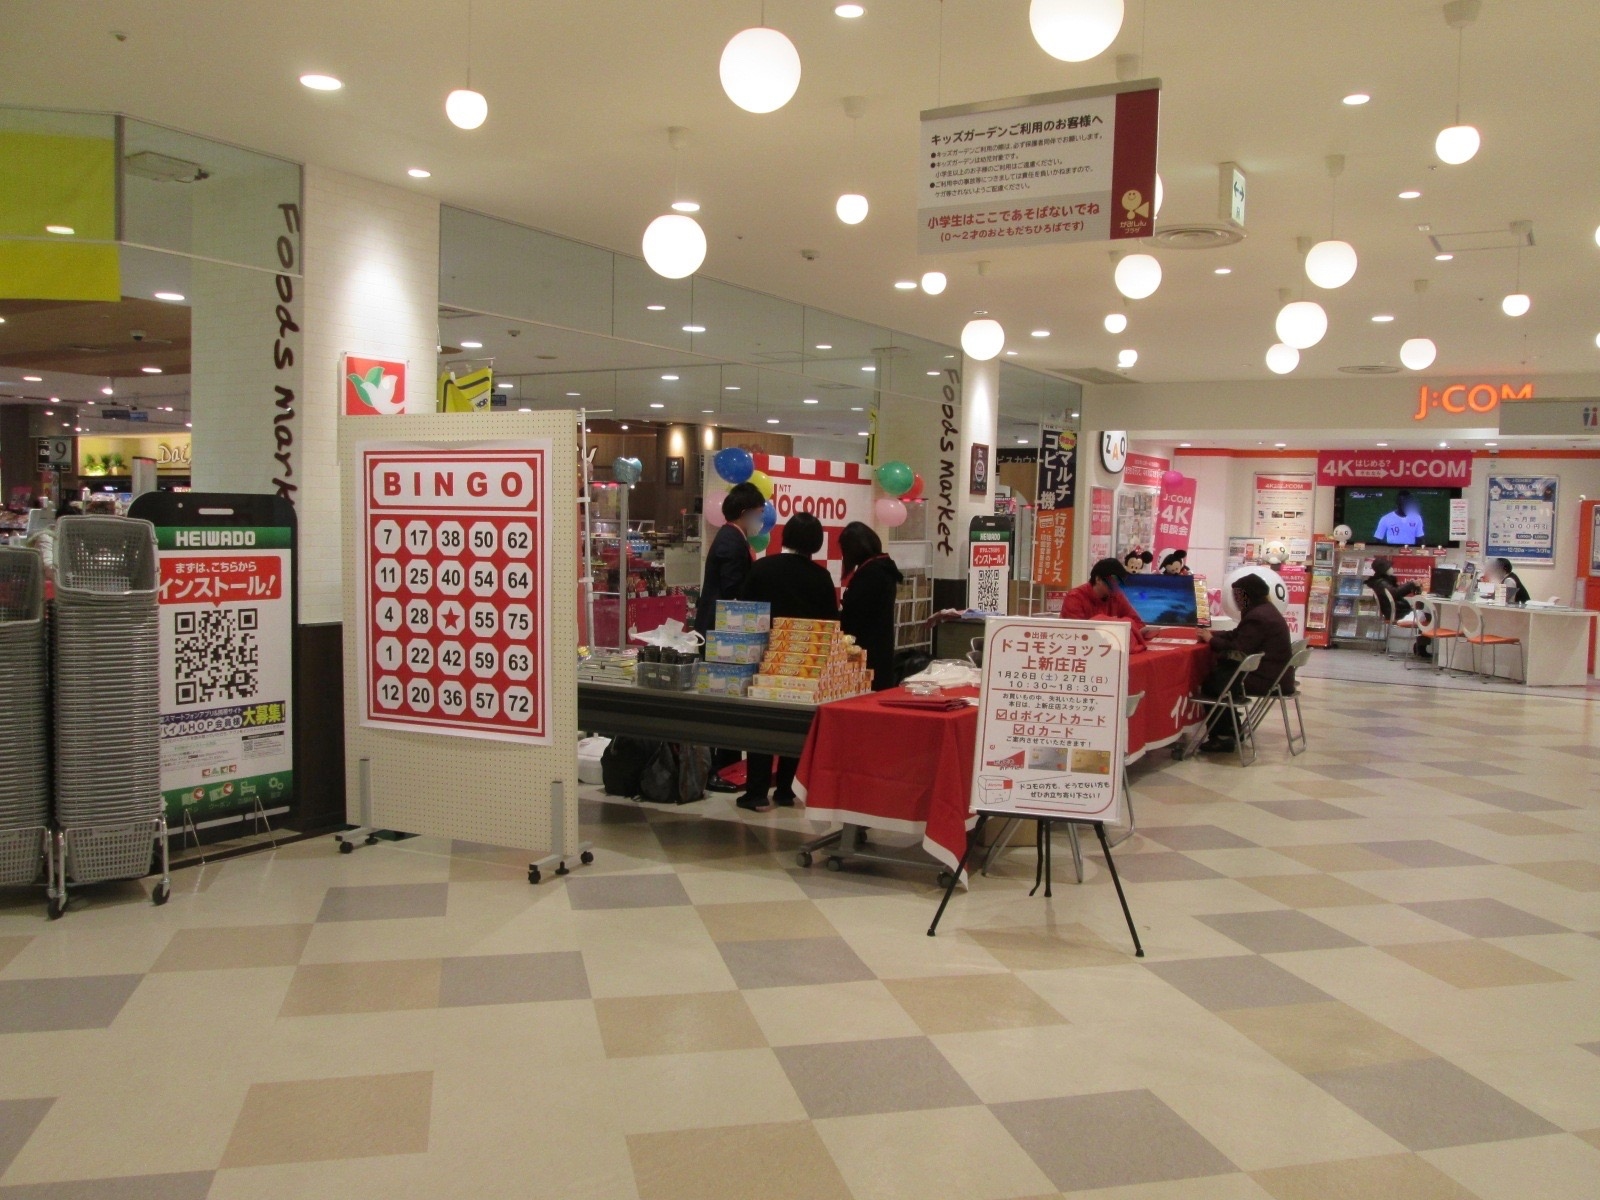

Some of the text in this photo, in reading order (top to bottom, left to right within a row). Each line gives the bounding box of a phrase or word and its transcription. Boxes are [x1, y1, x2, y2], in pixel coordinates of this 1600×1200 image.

[931, 114, 1103, 146] キッズガーデンご利用のお客様へ
[928, 202, 1100, 230] 小学生はここであそばないでね
[271, 202, 300, 505] Foods Mark
[1413, 383, 1535, 420] J:COM
[55, 441, 67, 460] 9
[157, 442, 191, 464] Dai
[937, 367, 961, 558] Foods Market
[1041, 434, 1059, 510] コピー機
[1322, 459, 1355, 477] 4K
[1355, 460, 1391, 468] はじめる?
[1389, 459, 1466, 478] J:COM
[383, 471, 523, 498] BINGO
[1056, 450, 1073, 502] マルチ
[778, 484, 791, 493] NTT
[1163, 493, 1192, 504] J:COM
[771, 483, 847, 520] docomo
[1161, 504, 1190, 525] 4K
[175, 530, 256, 546] HEIWADO
[383, 528, 528, 549] 7 17 38 50 62
[1160, 522, 1189, 536] 相談会
[1052, 512, 1067, 583] 行政サービス
[175, 561, 257, 574] まずは、こちらから
[380, 566, 529, 589] 11 25 40 54 64
[159, 574, 276, 600] インストール!
[1287, 585, 1305, 593] COM
[384, 606, 529, 631] 4 28 55 75
[1031, 631, 1080, 641] 出張イベント
[385, 645, 529, 672] 1 22 42 59 63
[1021, 655, 1087, 673] 上新庄店
[381, 684, 529, 713] 12 20 36 57 72
[1008, 701, 1095, 712] 本日は、上新庄店スタッフが
[243, 703, 286, 726] 大募集!
[1010, 709, 1106, 727] dポイントカード
[161, 716, 242, 736] バイルHOP会員様
[1027, 726, 1074, 738] dカード
[1006, 735, 1092, 748] ご案内させていただきます!
[1020, 781, 1110, 791] ドコモの方も、そうでない方も
[1030, 791, 1101, 799] ぜひお立ち寄り下さい!
